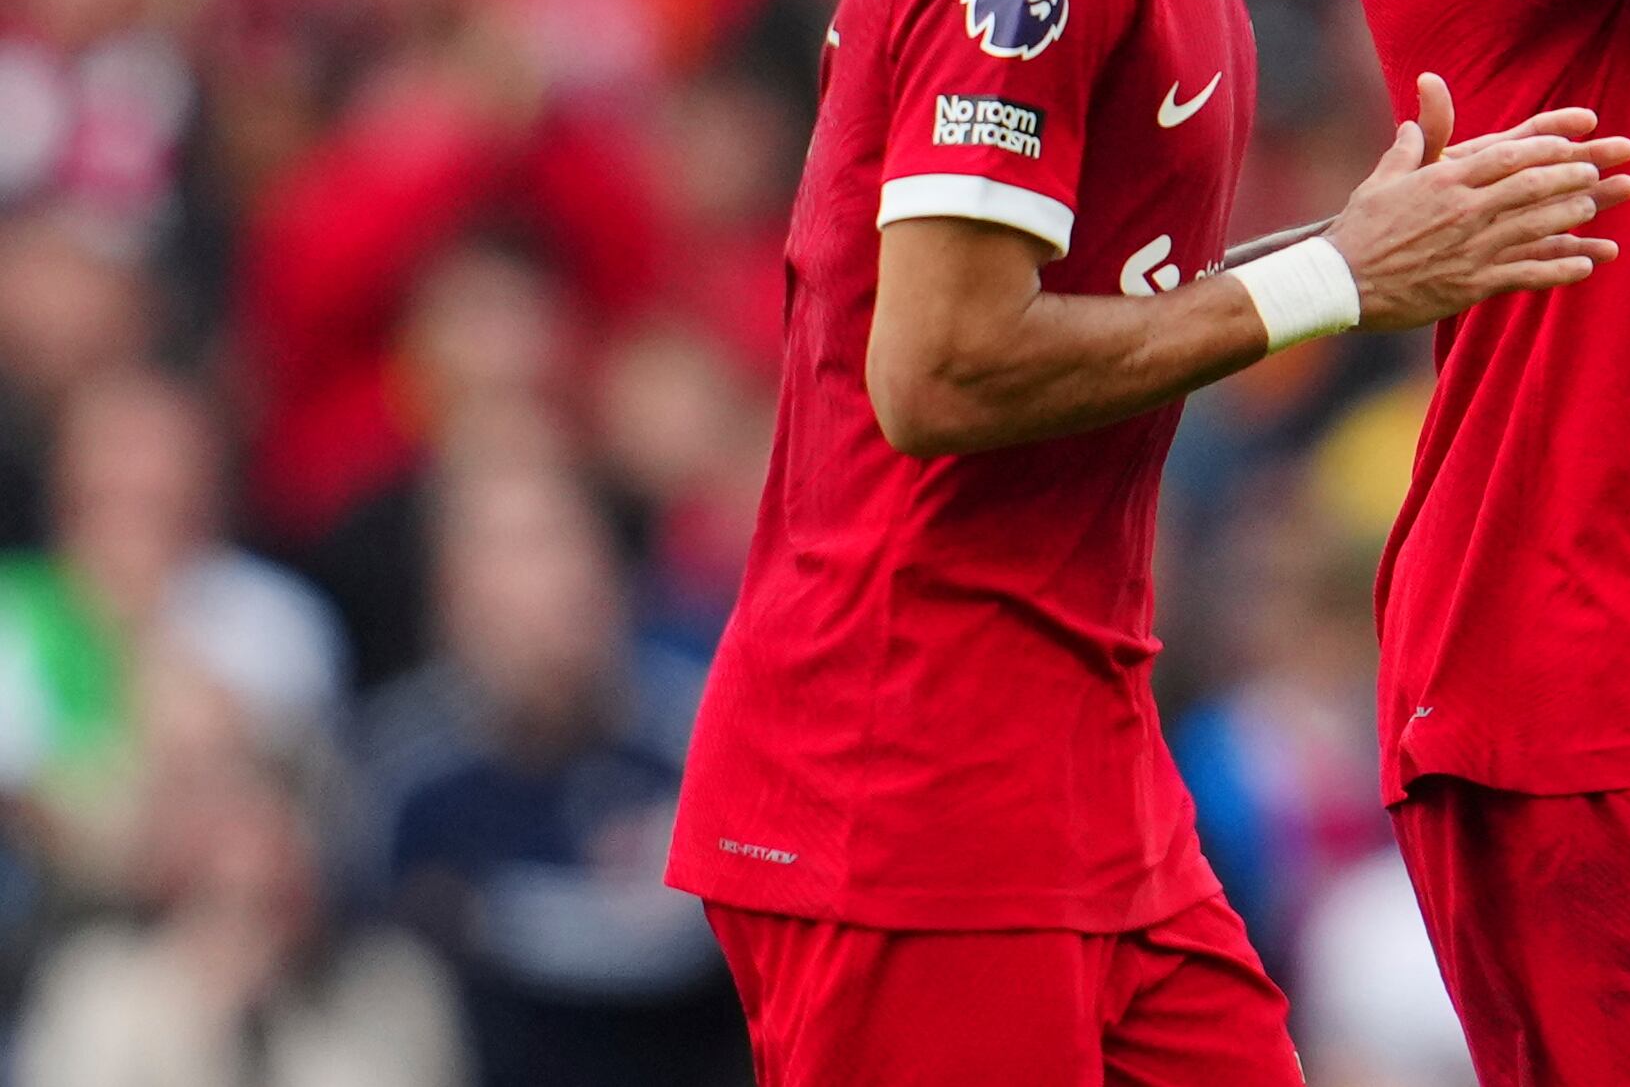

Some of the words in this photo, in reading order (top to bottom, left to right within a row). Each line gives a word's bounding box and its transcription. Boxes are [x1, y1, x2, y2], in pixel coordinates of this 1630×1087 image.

[935, 94, 974, 122] No
[975, 100, 1038, 134] room
[932, 119, 971, 146] for
[971, 122, 1042, 159] racism
